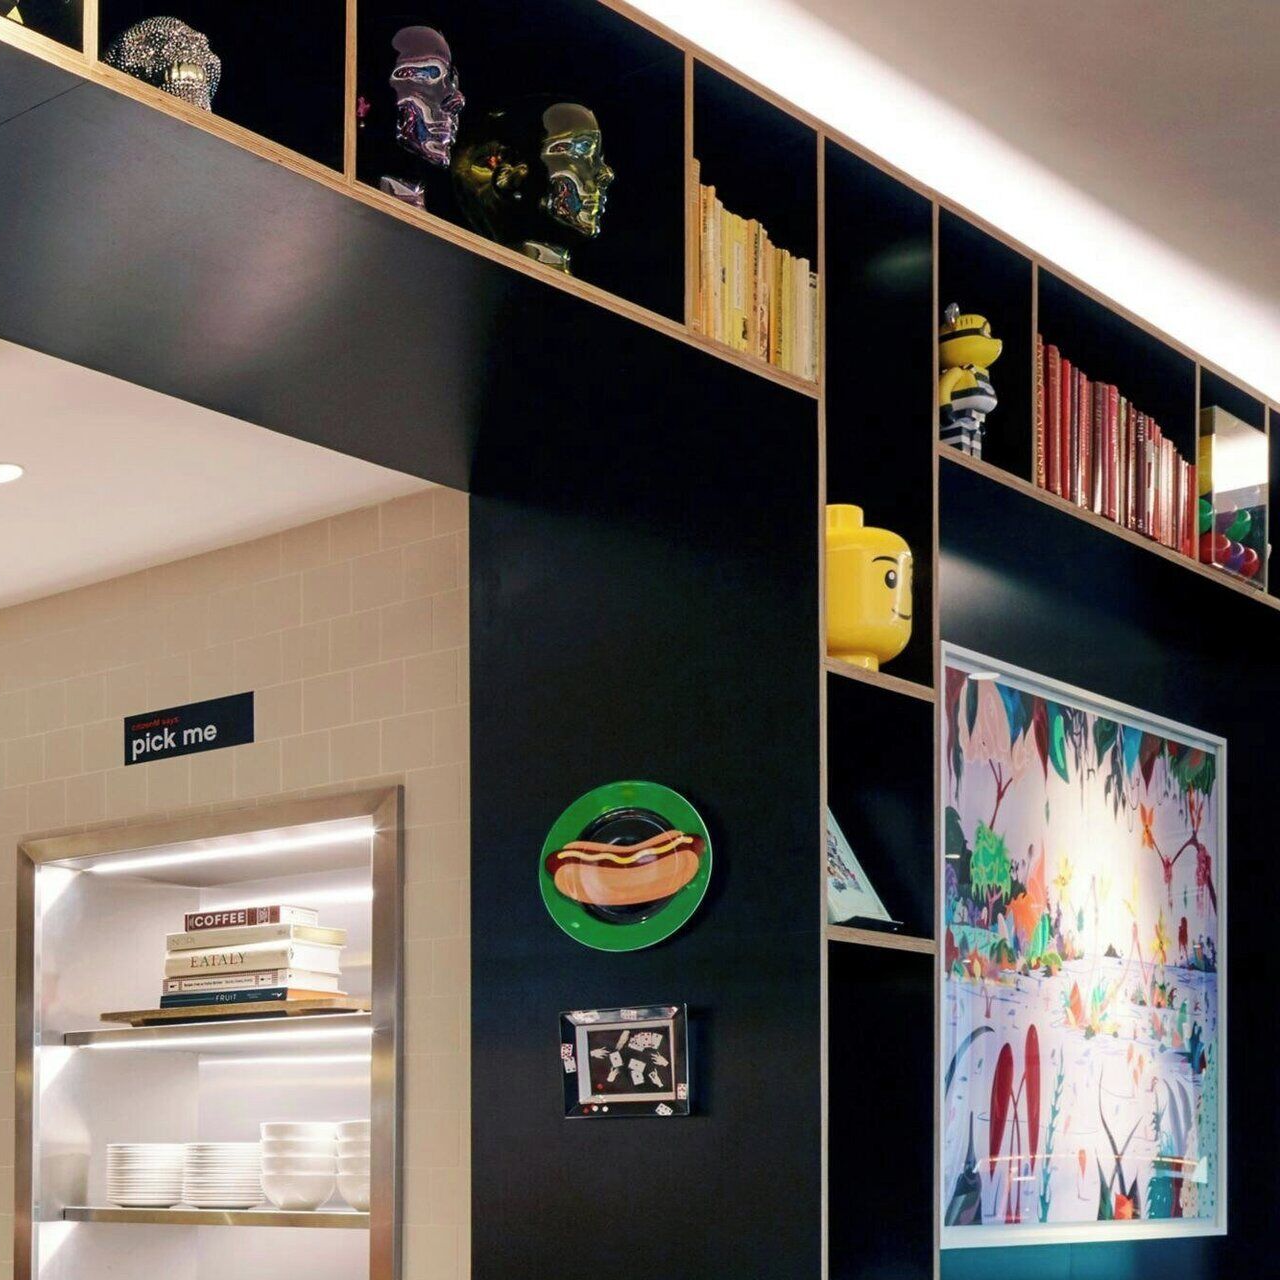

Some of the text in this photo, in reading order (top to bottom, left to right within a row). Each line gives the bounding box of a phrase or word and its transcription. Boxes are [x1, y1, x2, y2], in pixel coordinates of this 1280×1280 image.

[131, 724, 218, 761] pick me
[194, 912, 245, 928] COFFEE
[190, 951, 247, 968] EATALY
[215, 993, 237, 1002] FRUIT
